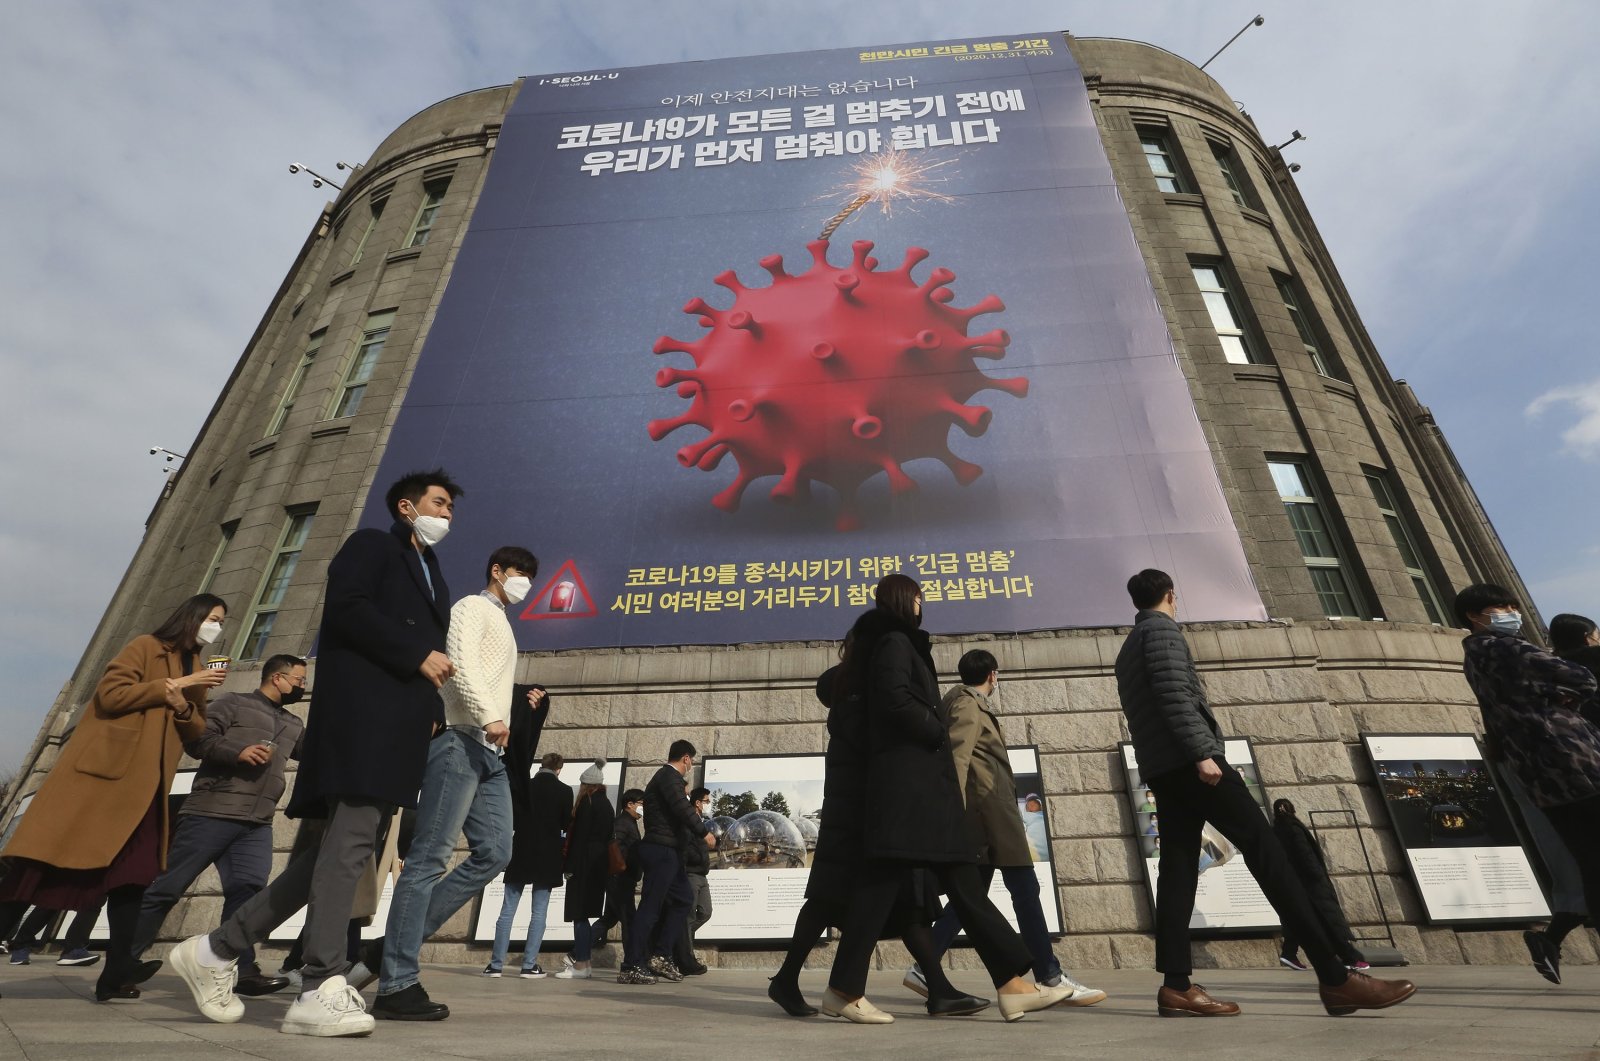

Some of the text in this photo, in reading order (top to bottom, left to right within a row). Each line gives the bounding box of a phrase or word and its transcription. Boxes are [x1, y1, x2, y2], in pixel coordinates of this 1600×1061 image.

[859, 47, 929, 61] 천만시민
[934, 44, 968, 55] 긴급
[1012, 38, 1050, 49] 기간
[661, 75, 919, 107] 이제 안전지대는 없습니다
[557, 89, 1026, 149] 코로나19가 모든 걸 멈추기 전에
[580, 118, 1000, 176] 우리가 먼저 멈춰야 합니다
[625, 563, 738, 586] 코로나19를
[743, 557, 852, 583] 종식시키기
[858, 555, 902, 578] 위한
[610, 592, 653, 615] 시민
[659, 588, 746, 613] 여러분의
[751, 585, 840, 609] 거리두기
[920, 575, 1034, 602] 절실합니다
